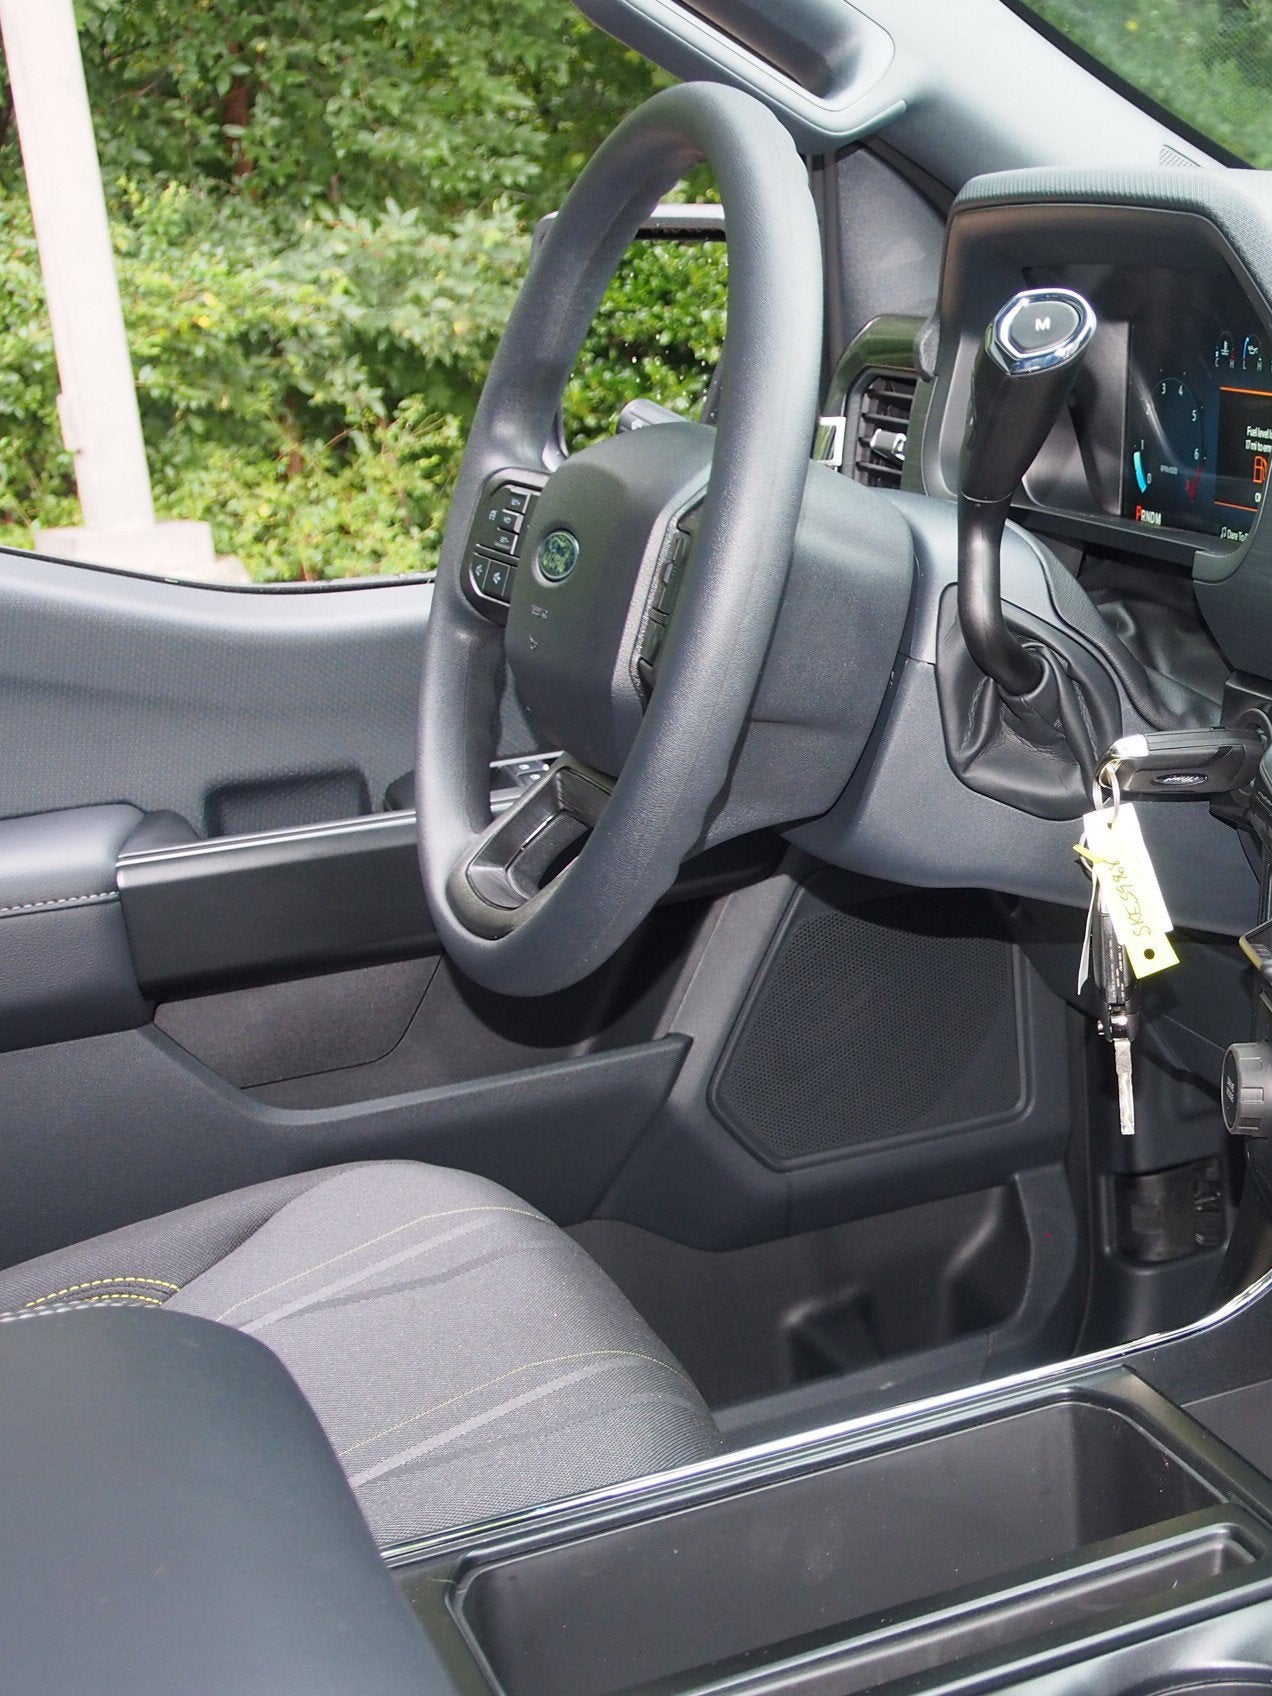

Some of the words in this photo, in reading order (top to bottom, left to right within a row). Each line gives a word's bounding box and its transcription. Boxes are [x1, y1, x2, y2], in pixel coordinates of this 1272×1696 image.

[1035, 317, 1051, 331] M
[1161, 382, 1166, 395] 3
[1178, 384, 1183, 397] 4
[1191, 409, 1197, 422] 5
[1194, 448, 1199, 460] 6
